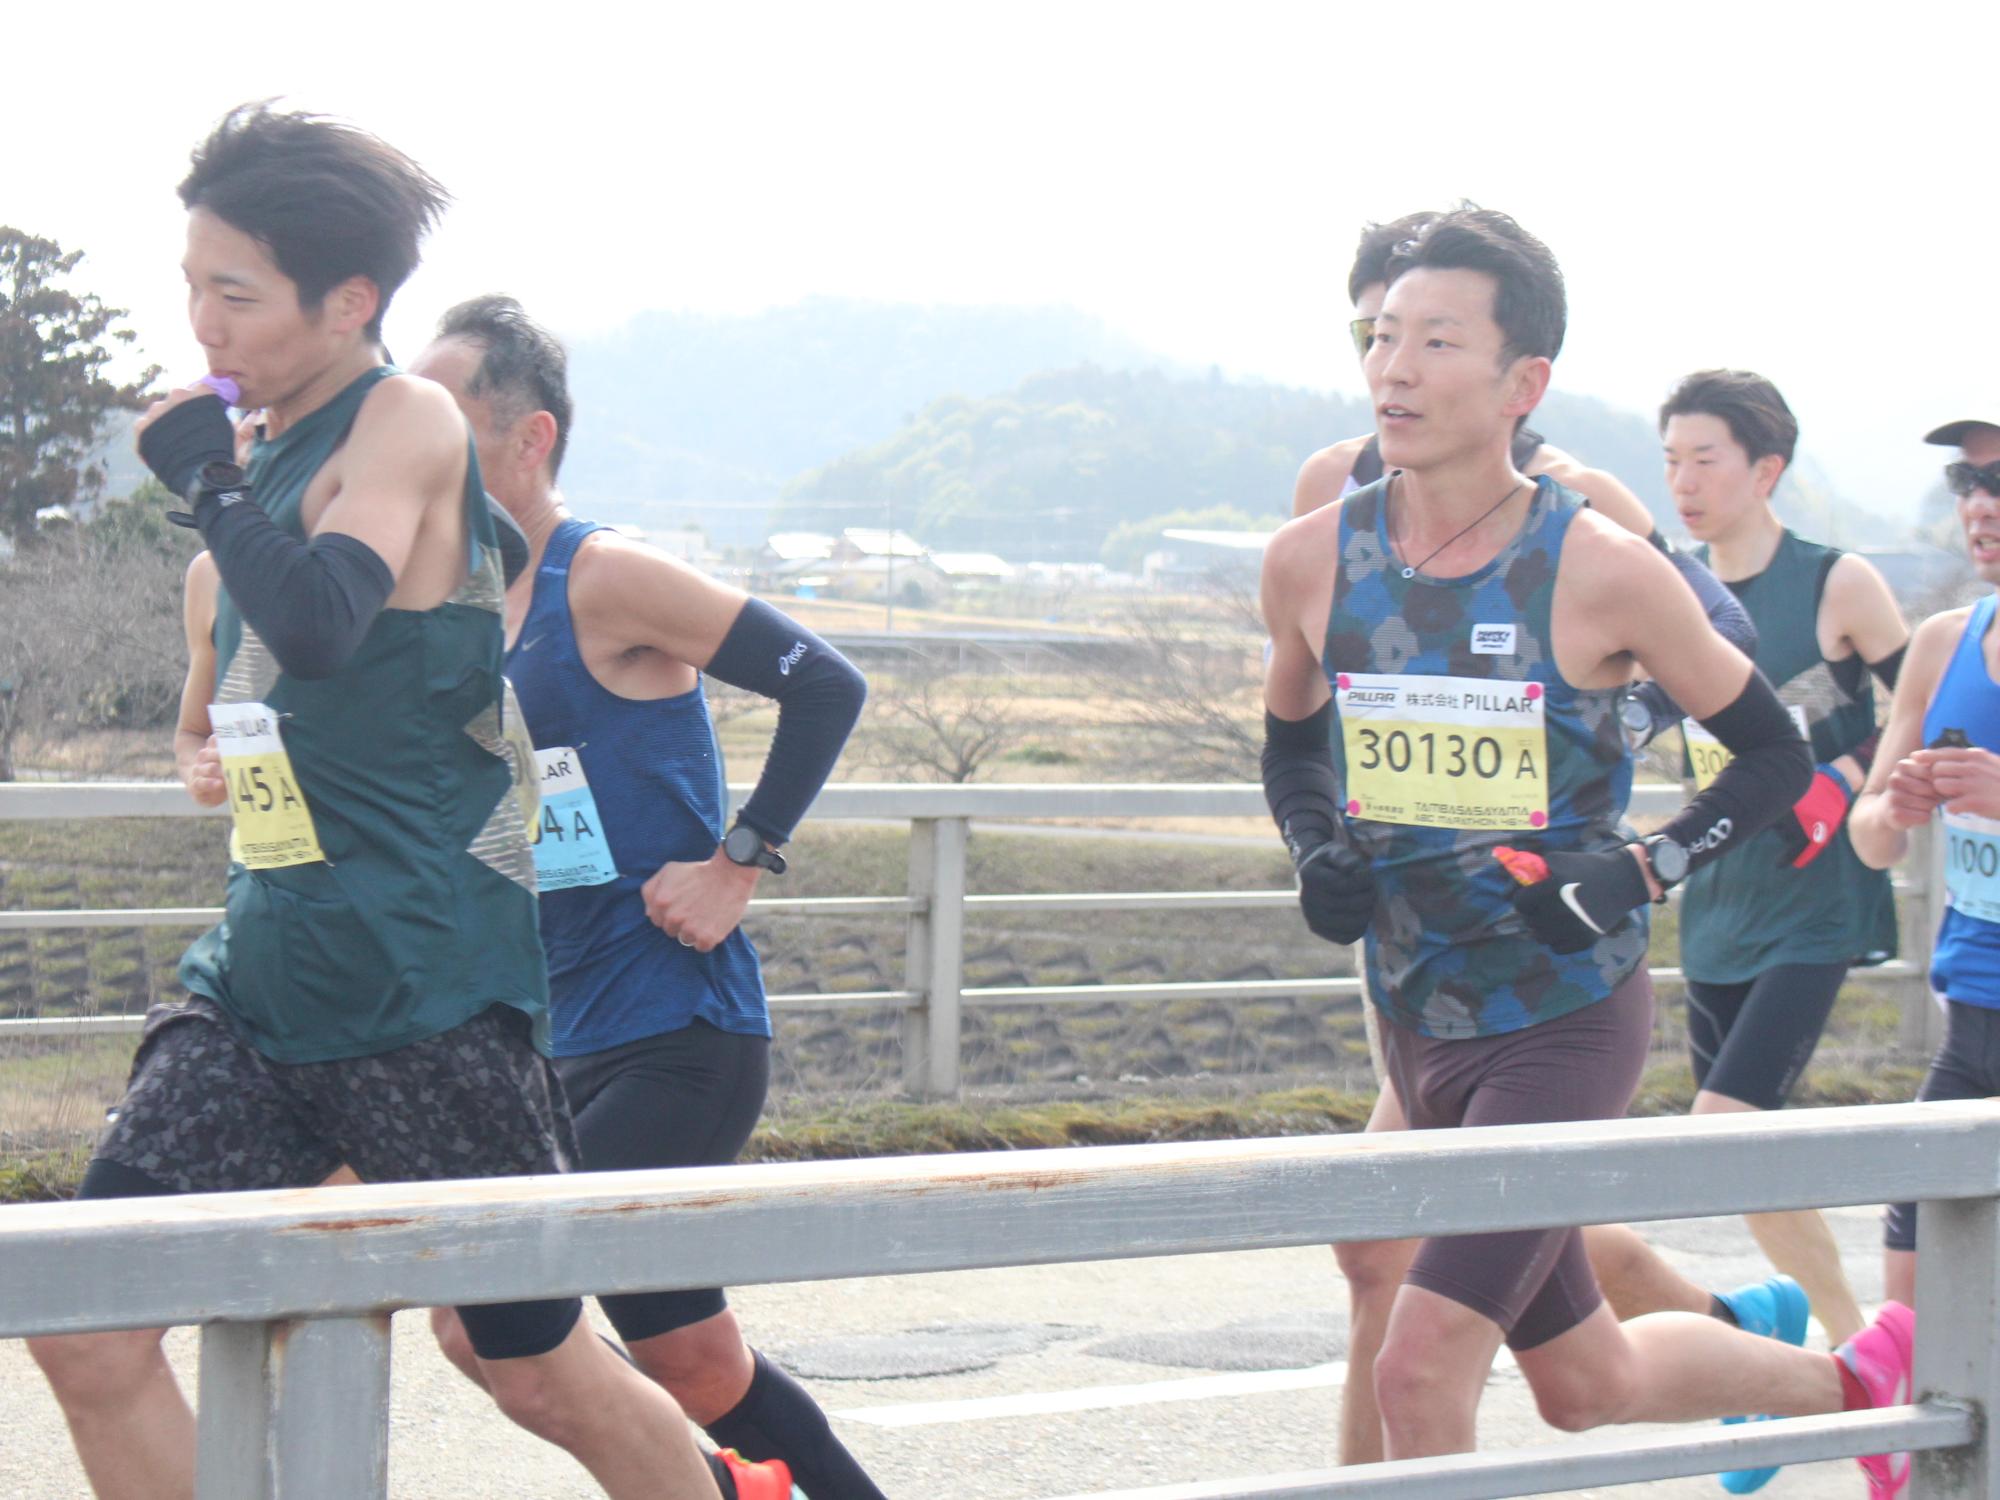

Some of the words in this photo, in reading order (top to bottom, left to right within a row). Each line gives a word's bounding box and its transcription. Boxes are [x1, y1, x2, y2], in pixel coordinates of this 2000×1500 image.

[1348, 691, 1396, 702] PILLAR
[1406, 693, 1459, 708] 株式会社
[1463, 693, 1534, 713] PILLAR
[1358, 727, 1503, 779] 30130
[1515, 749, 1538, 779] A
[1694, 748, 1733, 777] 30
[280, 777, 302, 811] A
[573, 811, 594, 841] A
[1950, 834, 1999, 877] 100
